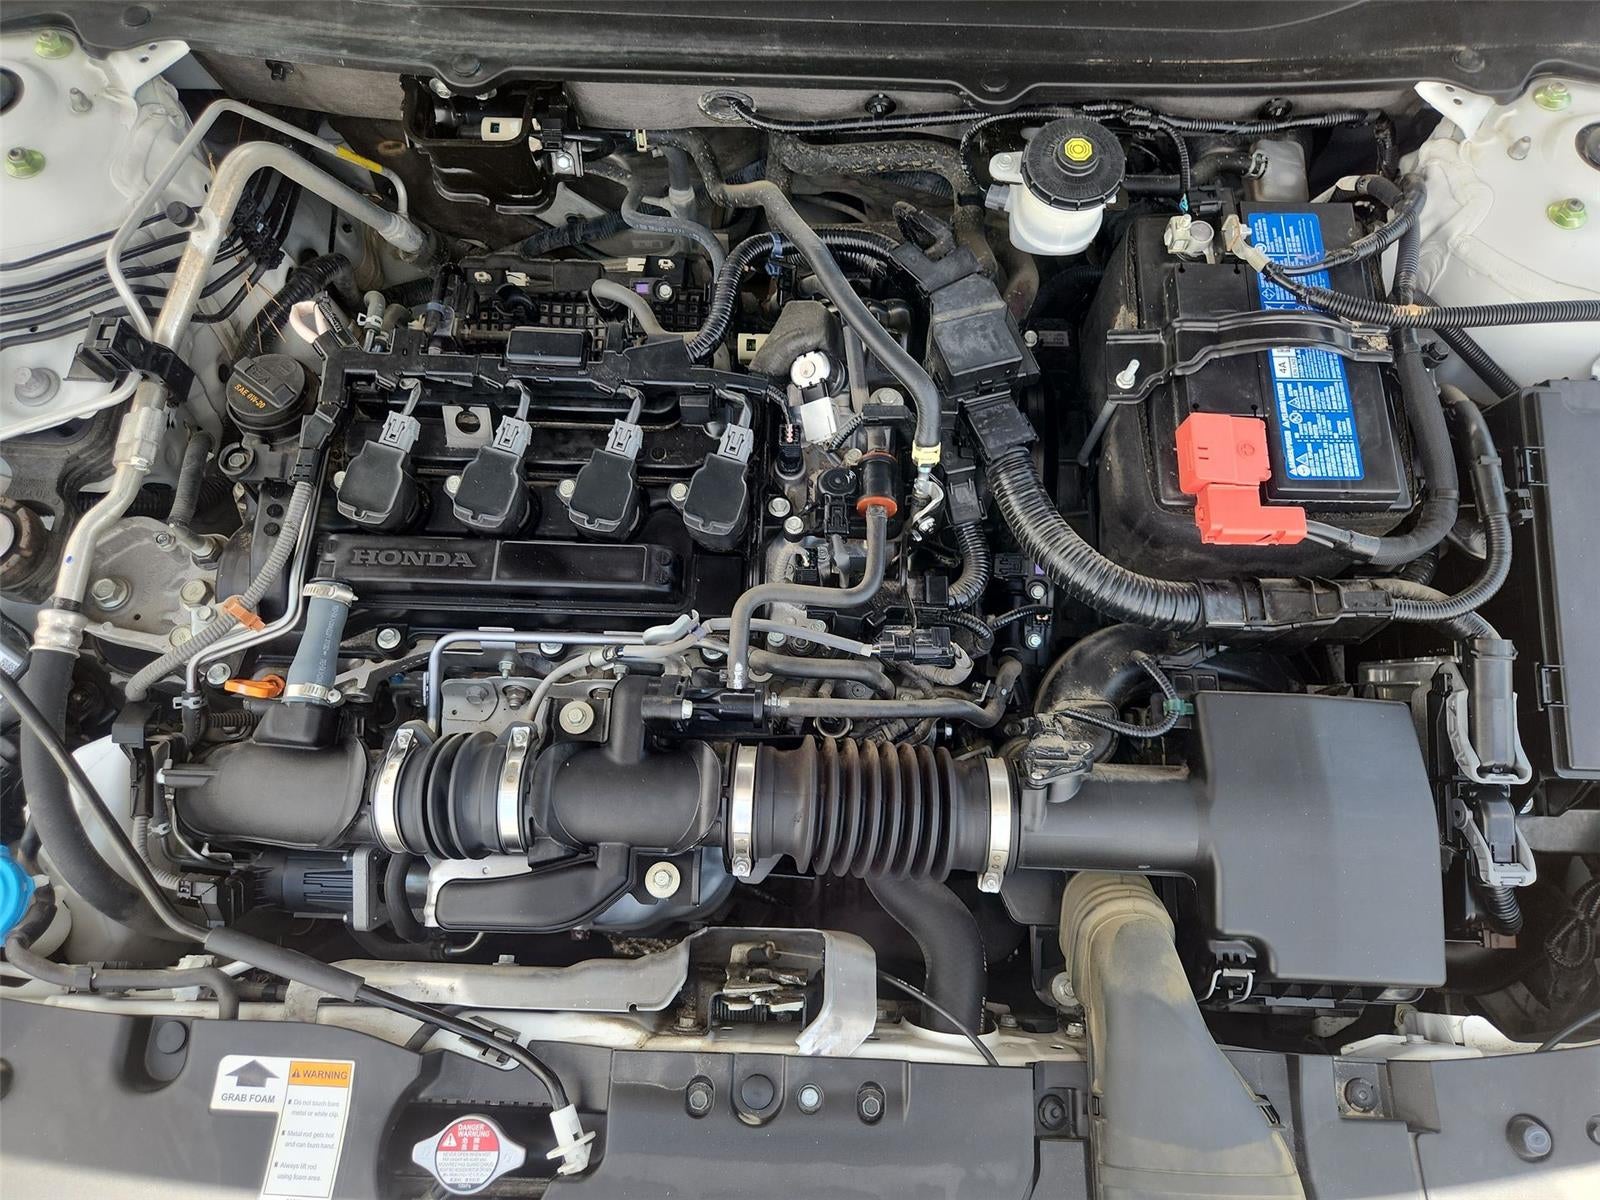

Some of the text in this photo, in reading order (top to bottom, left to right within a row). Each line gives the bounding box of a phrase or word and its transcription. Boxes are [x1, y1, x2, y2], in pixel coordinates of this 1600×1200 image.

[1278, 362, 1287, 374] 4A
[234, 384, 266, 409] SAE 0W-20
[351, 549, 477, 568] HONDA
[302, 1069, 348, 1081] WARNING
[221, 1092, 276, 1104] GRAB FOAM
[458, 1123, 484, 1131] DANGER
[287, 1130, 302, 1138] Metal
[279, 1162, 299, 1170] Always
